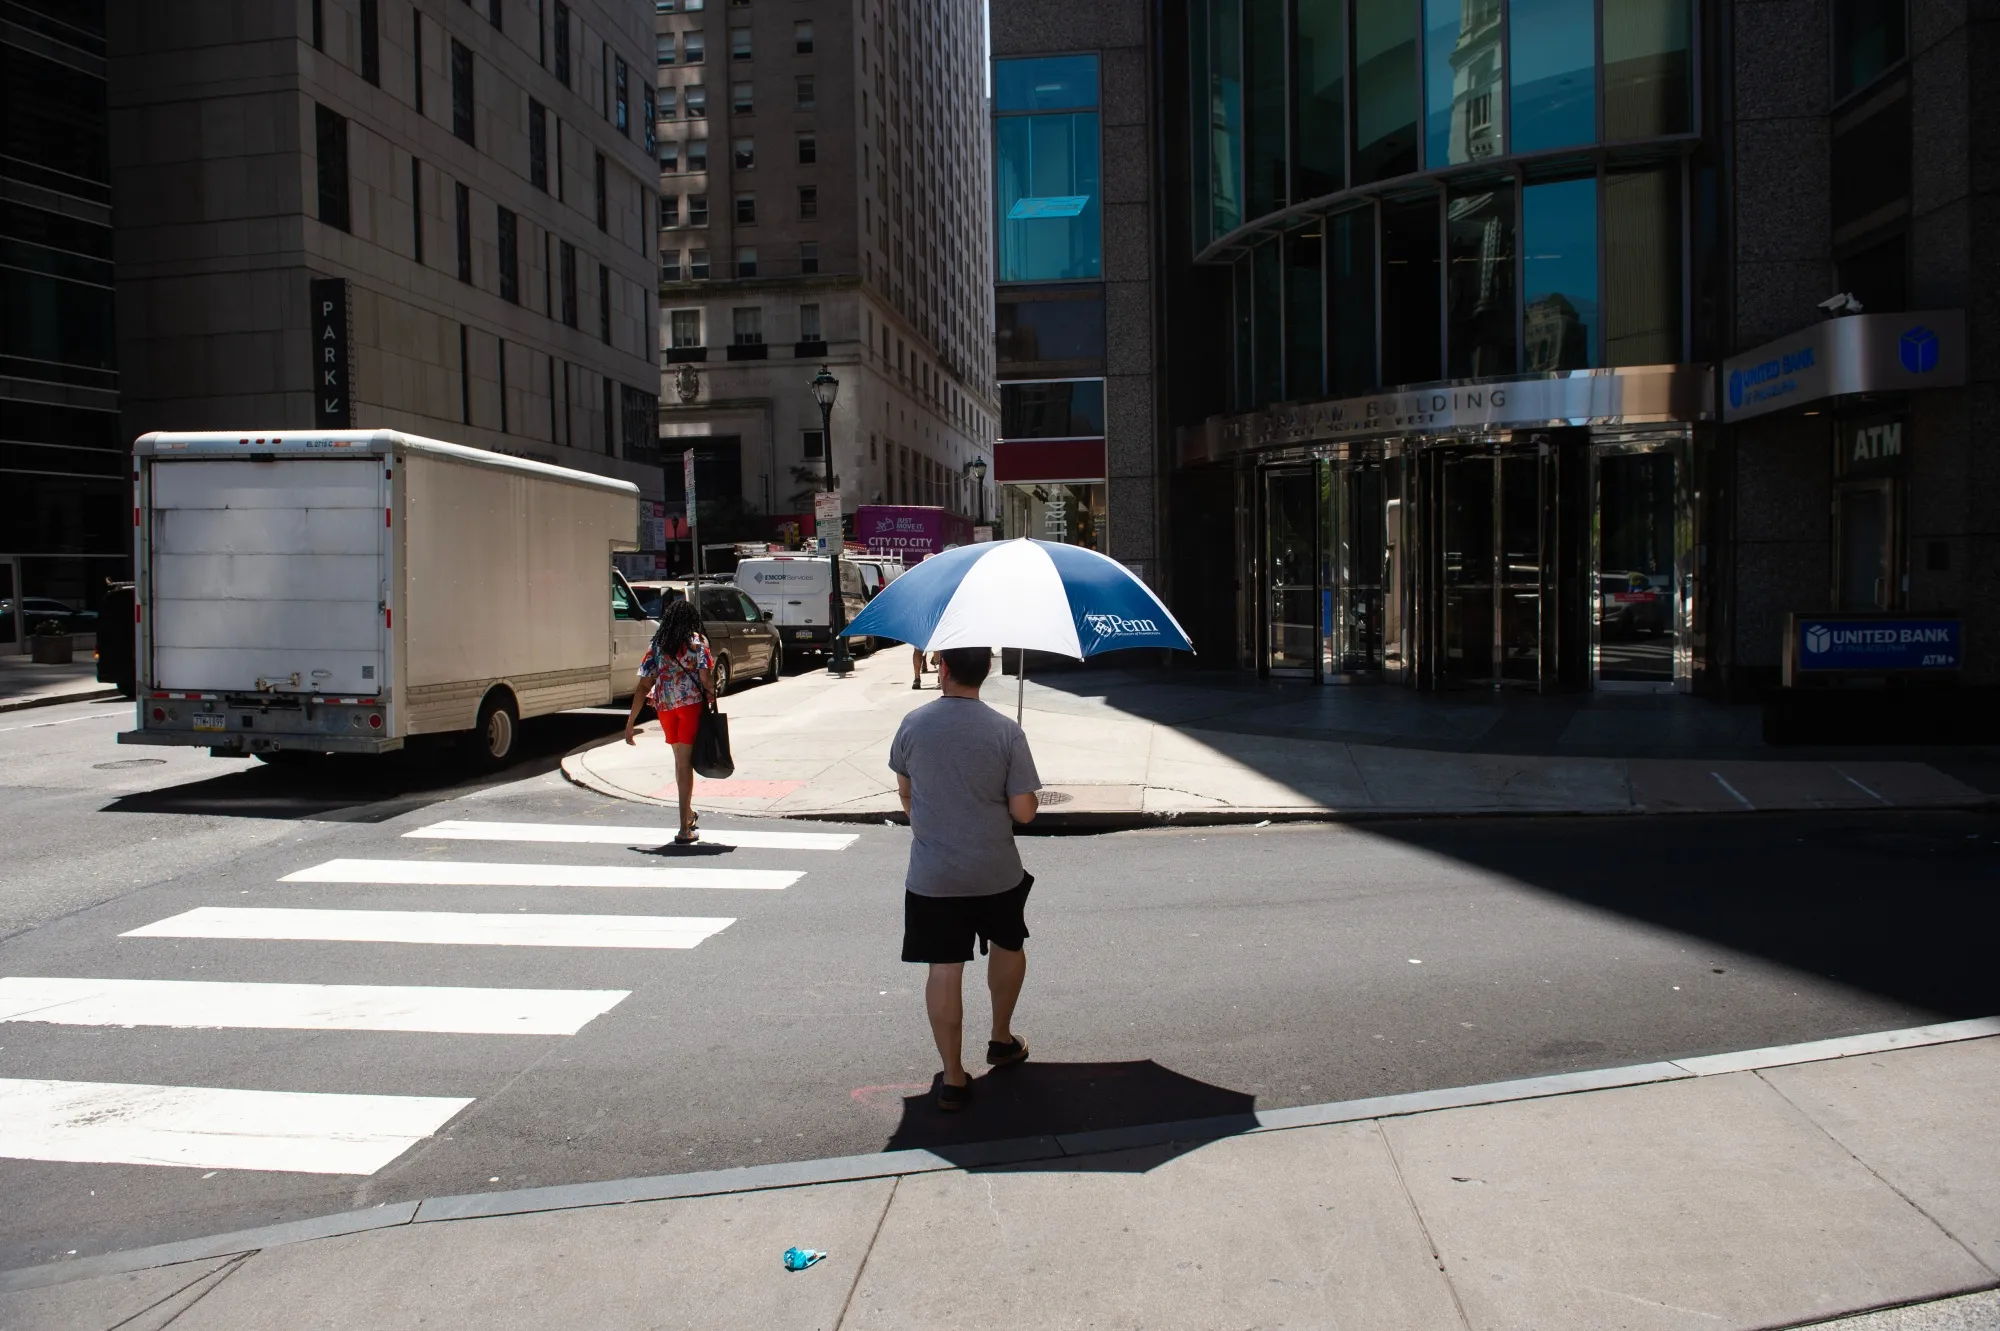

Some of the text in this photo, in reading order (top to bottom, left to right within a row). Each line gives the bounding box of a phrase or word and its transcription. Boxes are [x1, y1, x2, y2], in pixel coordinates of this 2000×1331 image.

[322, 301, 338, 386] PARK
[1743, 347, 1815, 387] UNITED BANK
[1366, 390, 1508, 418] BUILDING
[1395, 414, 1435, 425] WEST
[1853, 423, 1902, 461] ATM
[1045, 501, 1067, 536] PRET
[868, 537, 933, 547] CITY TO CITY
[1106, 614, 1159, 633] Penn
[1833, 628, 1950, 644] UNITED BANK
[1921, 654, 1946, 665] ATM
